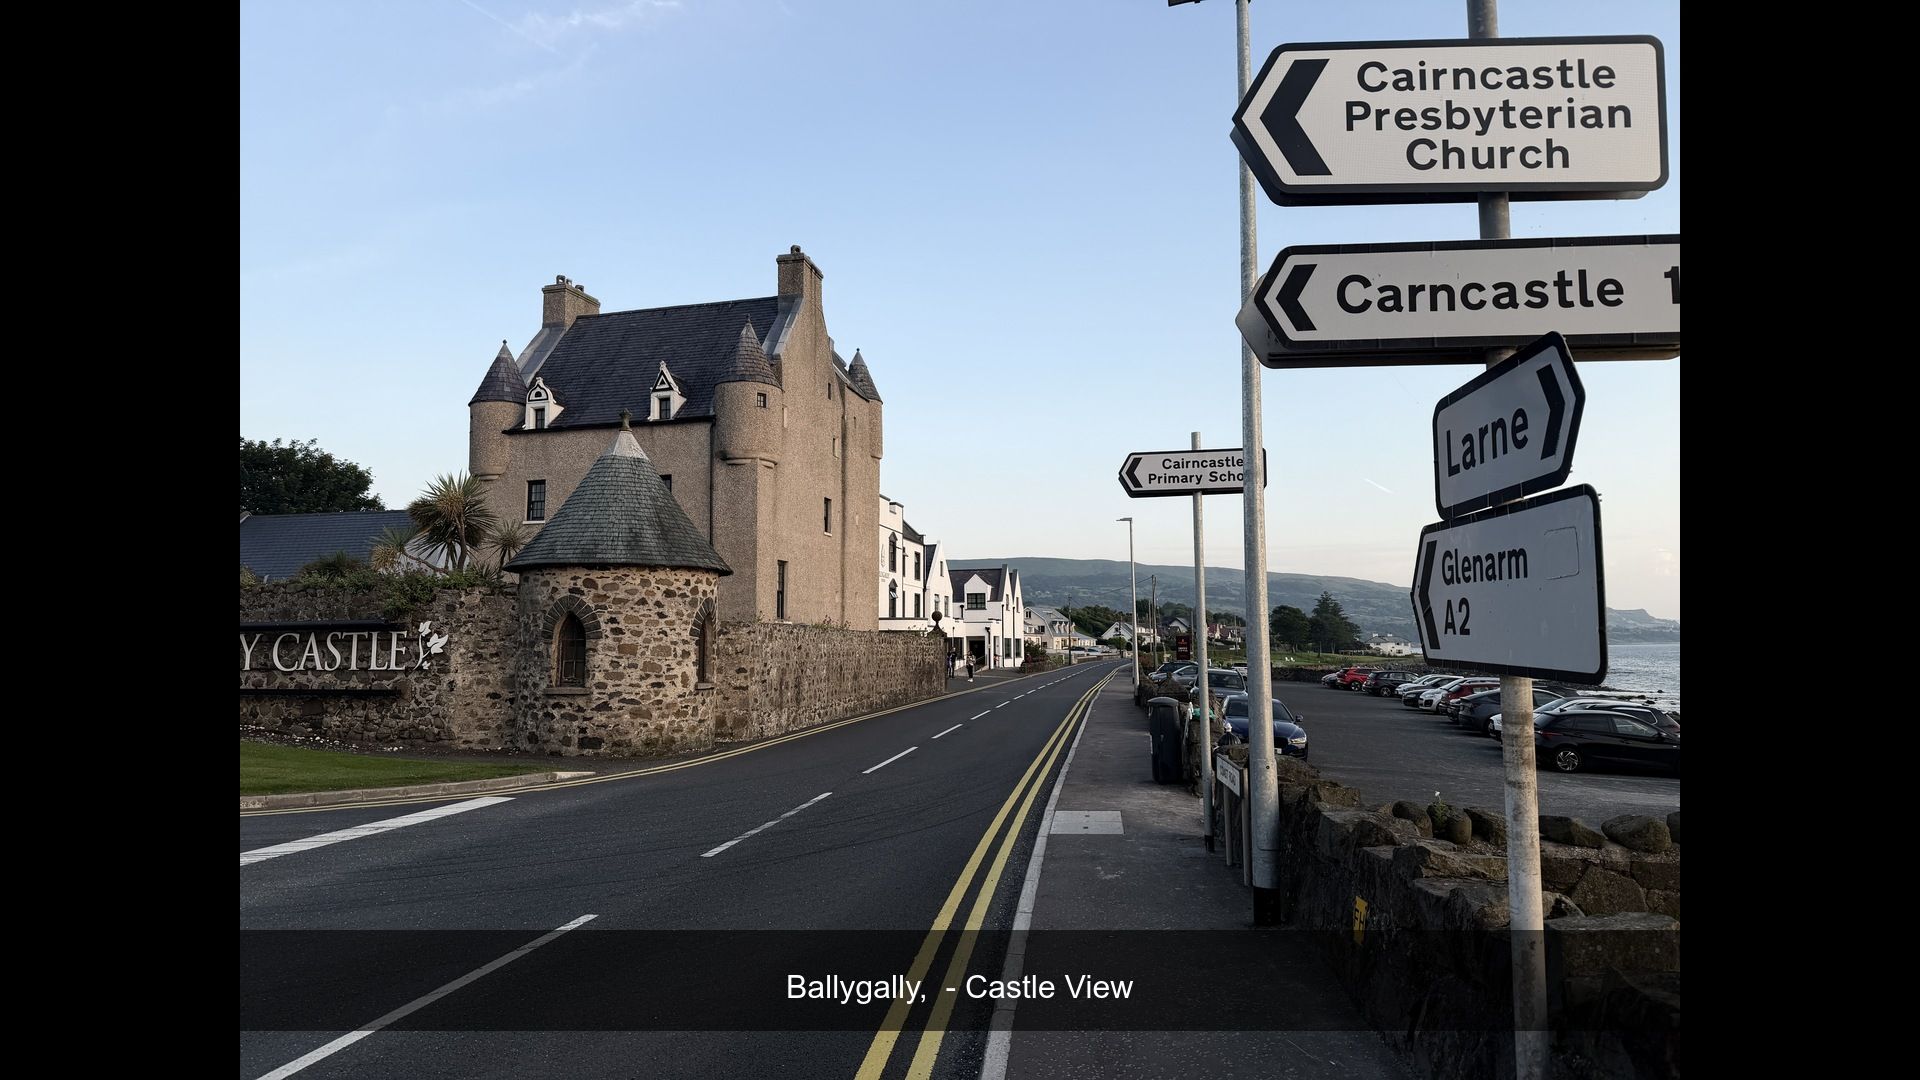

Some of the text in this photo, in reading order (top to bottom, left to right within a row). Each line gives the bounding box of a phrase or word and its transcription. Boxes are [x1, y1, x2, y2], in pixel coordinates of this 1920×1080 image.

[1357, 58, 1616, 93] Cairncastle
[1345, 97, 1632, 136] Presbyterian
[1406, 138, 1570, 171] Church
[1336, 268, 1625, 314] Carncastle
[1446, 407, 1529, 478] Larne
[1148, 470, 1243, 485] Primary Scho
[1162, 456, 1243, 470] Cairncastle
[1442, 547, 1529, 586] Glenarm
[1444, 597, 1471, 636] A2
[272, 630, 408, 672] CASTLE
